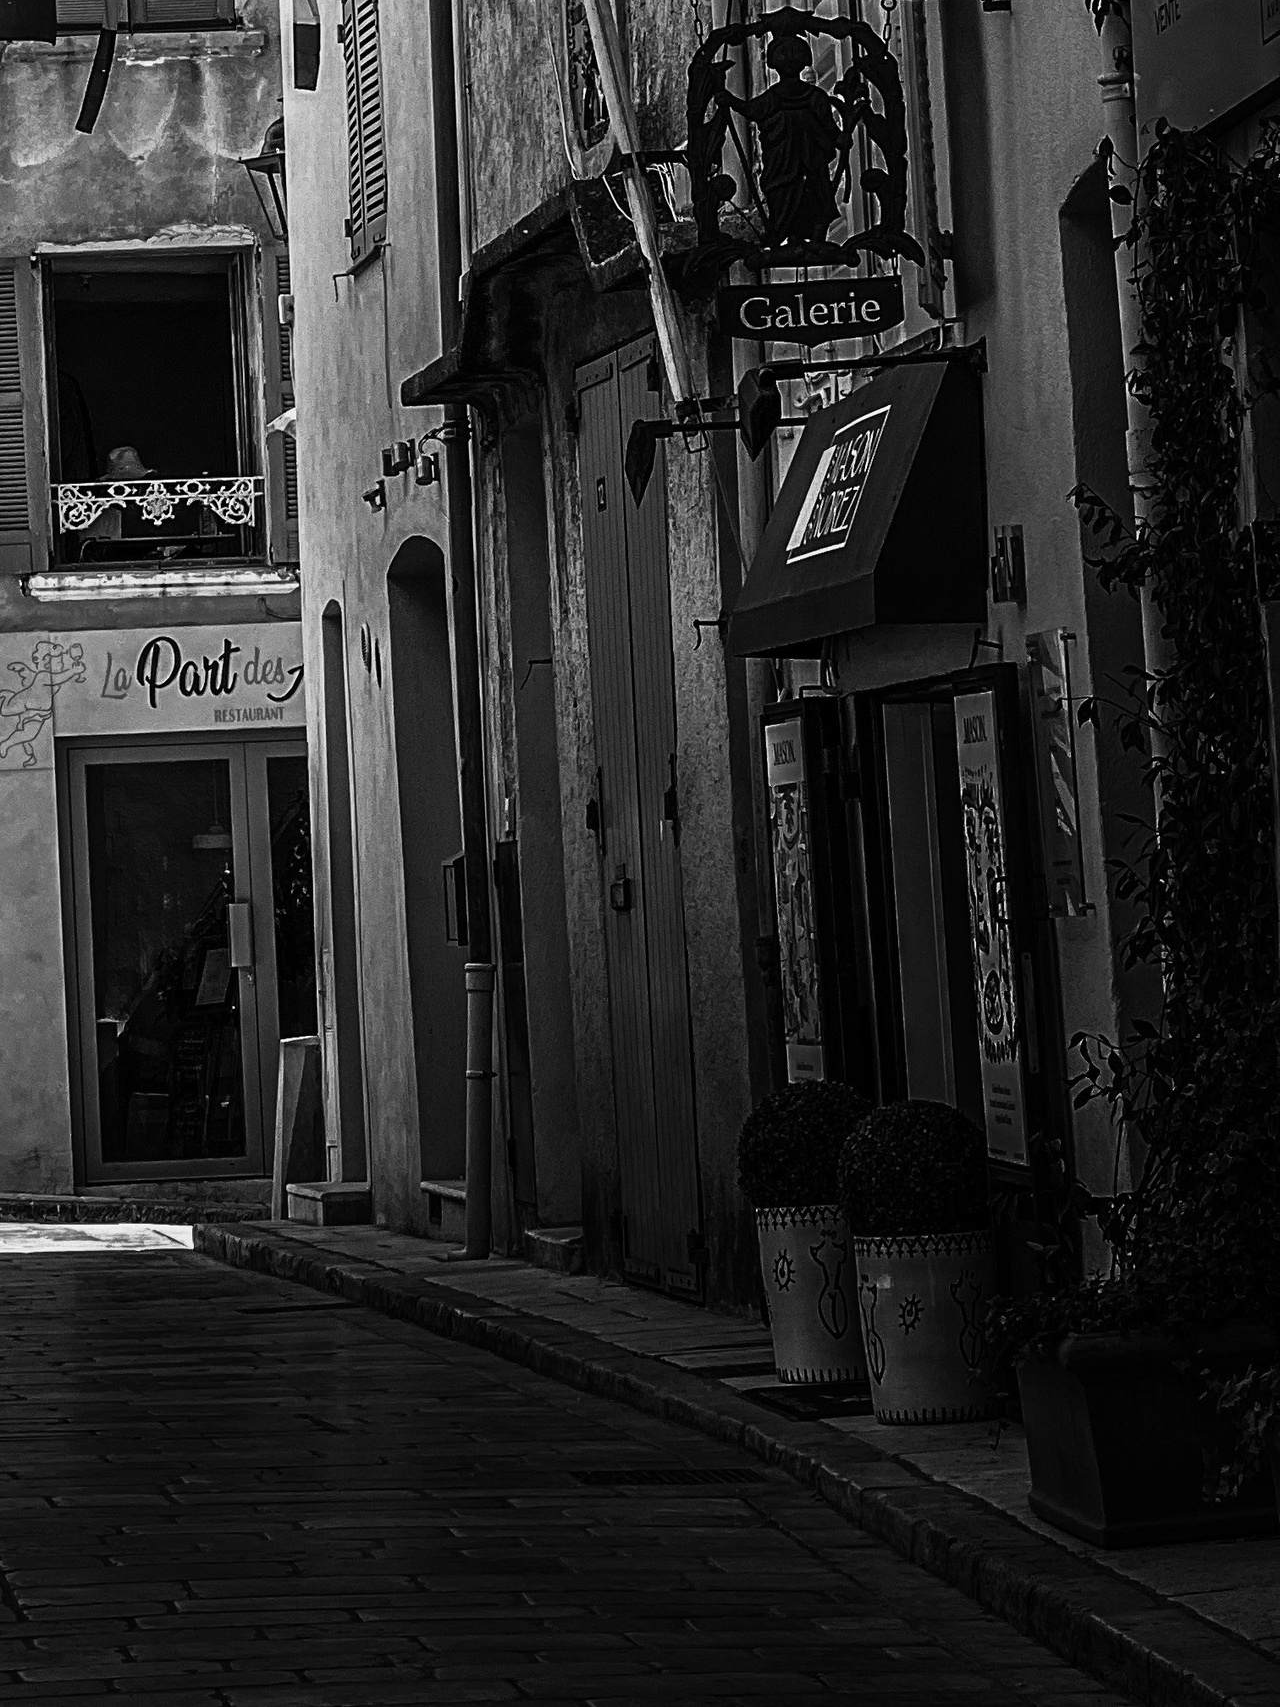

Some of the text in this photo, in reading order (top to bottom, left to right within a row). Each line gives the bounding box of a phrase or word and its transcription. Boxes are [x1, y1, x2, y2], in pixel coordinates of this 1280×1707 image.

[739, 291, 881, 330] Galerie
[101, 651, 132, 699] La
[136, 635, 241, 709] Part
[244, 646, 285, 685] des
[214, 706, 285, 723] RESTAURANT
